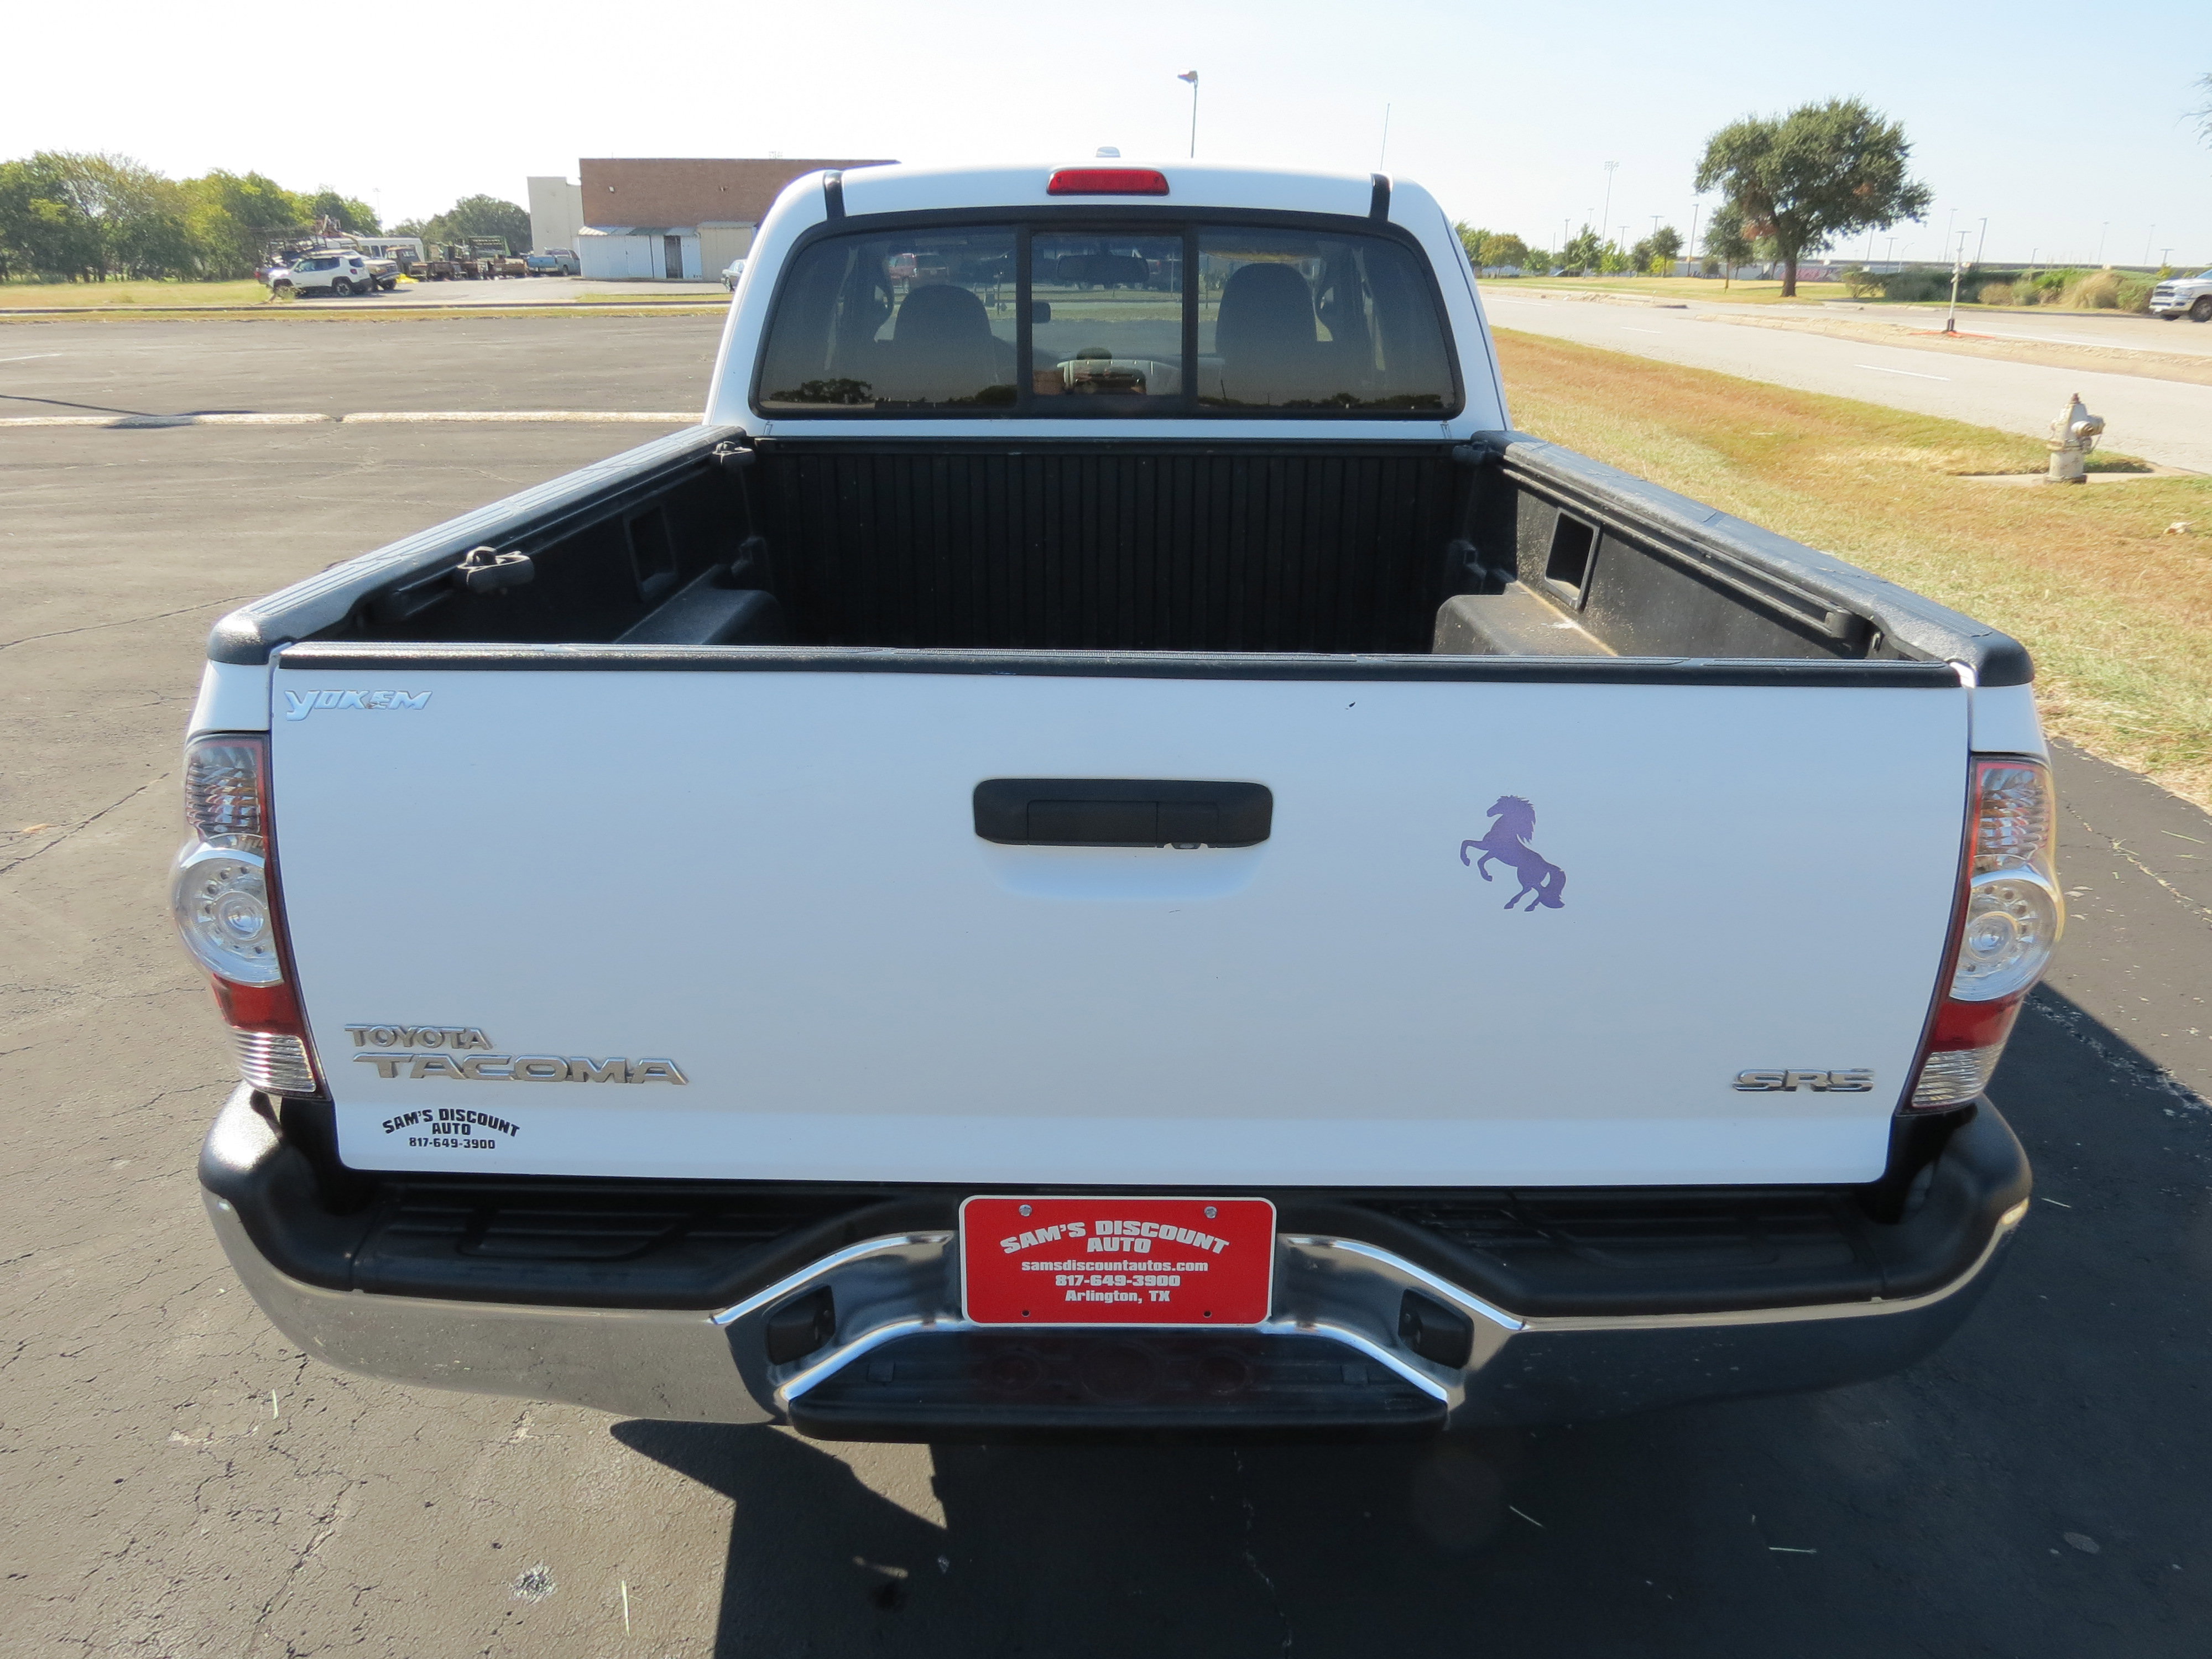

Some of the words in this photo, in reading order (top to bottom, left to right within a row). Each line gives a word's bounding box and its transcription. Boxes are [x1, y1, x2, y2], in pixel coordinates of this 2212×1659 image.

[344, 1024, 493, 1050] TOYOTA
[353, 1052, 690, 1086] TACOMA
[382, 1109, 434, 1134] SAM'S
[439, 1108, 520, 1137] DISCOUNT
[432, 1123, 472, 1135] AUTO
[409, 1137, 496, 1149] 817-649-3900
[1000, 1221, 1086, 1254] SAM'S
[1095, 1220, 1230, 1254] DISCOUNT
[1087, 1237, 1152, 1253] AUTO
[1021, 1259, 1208, 1272] samsdiscountautos.com
[1055, 1275, 1181, 1287] 817-649-3900
[1065, 1289, 1143, 1304] Arlington,
[1148, 1290, 1171, 1302] TX
